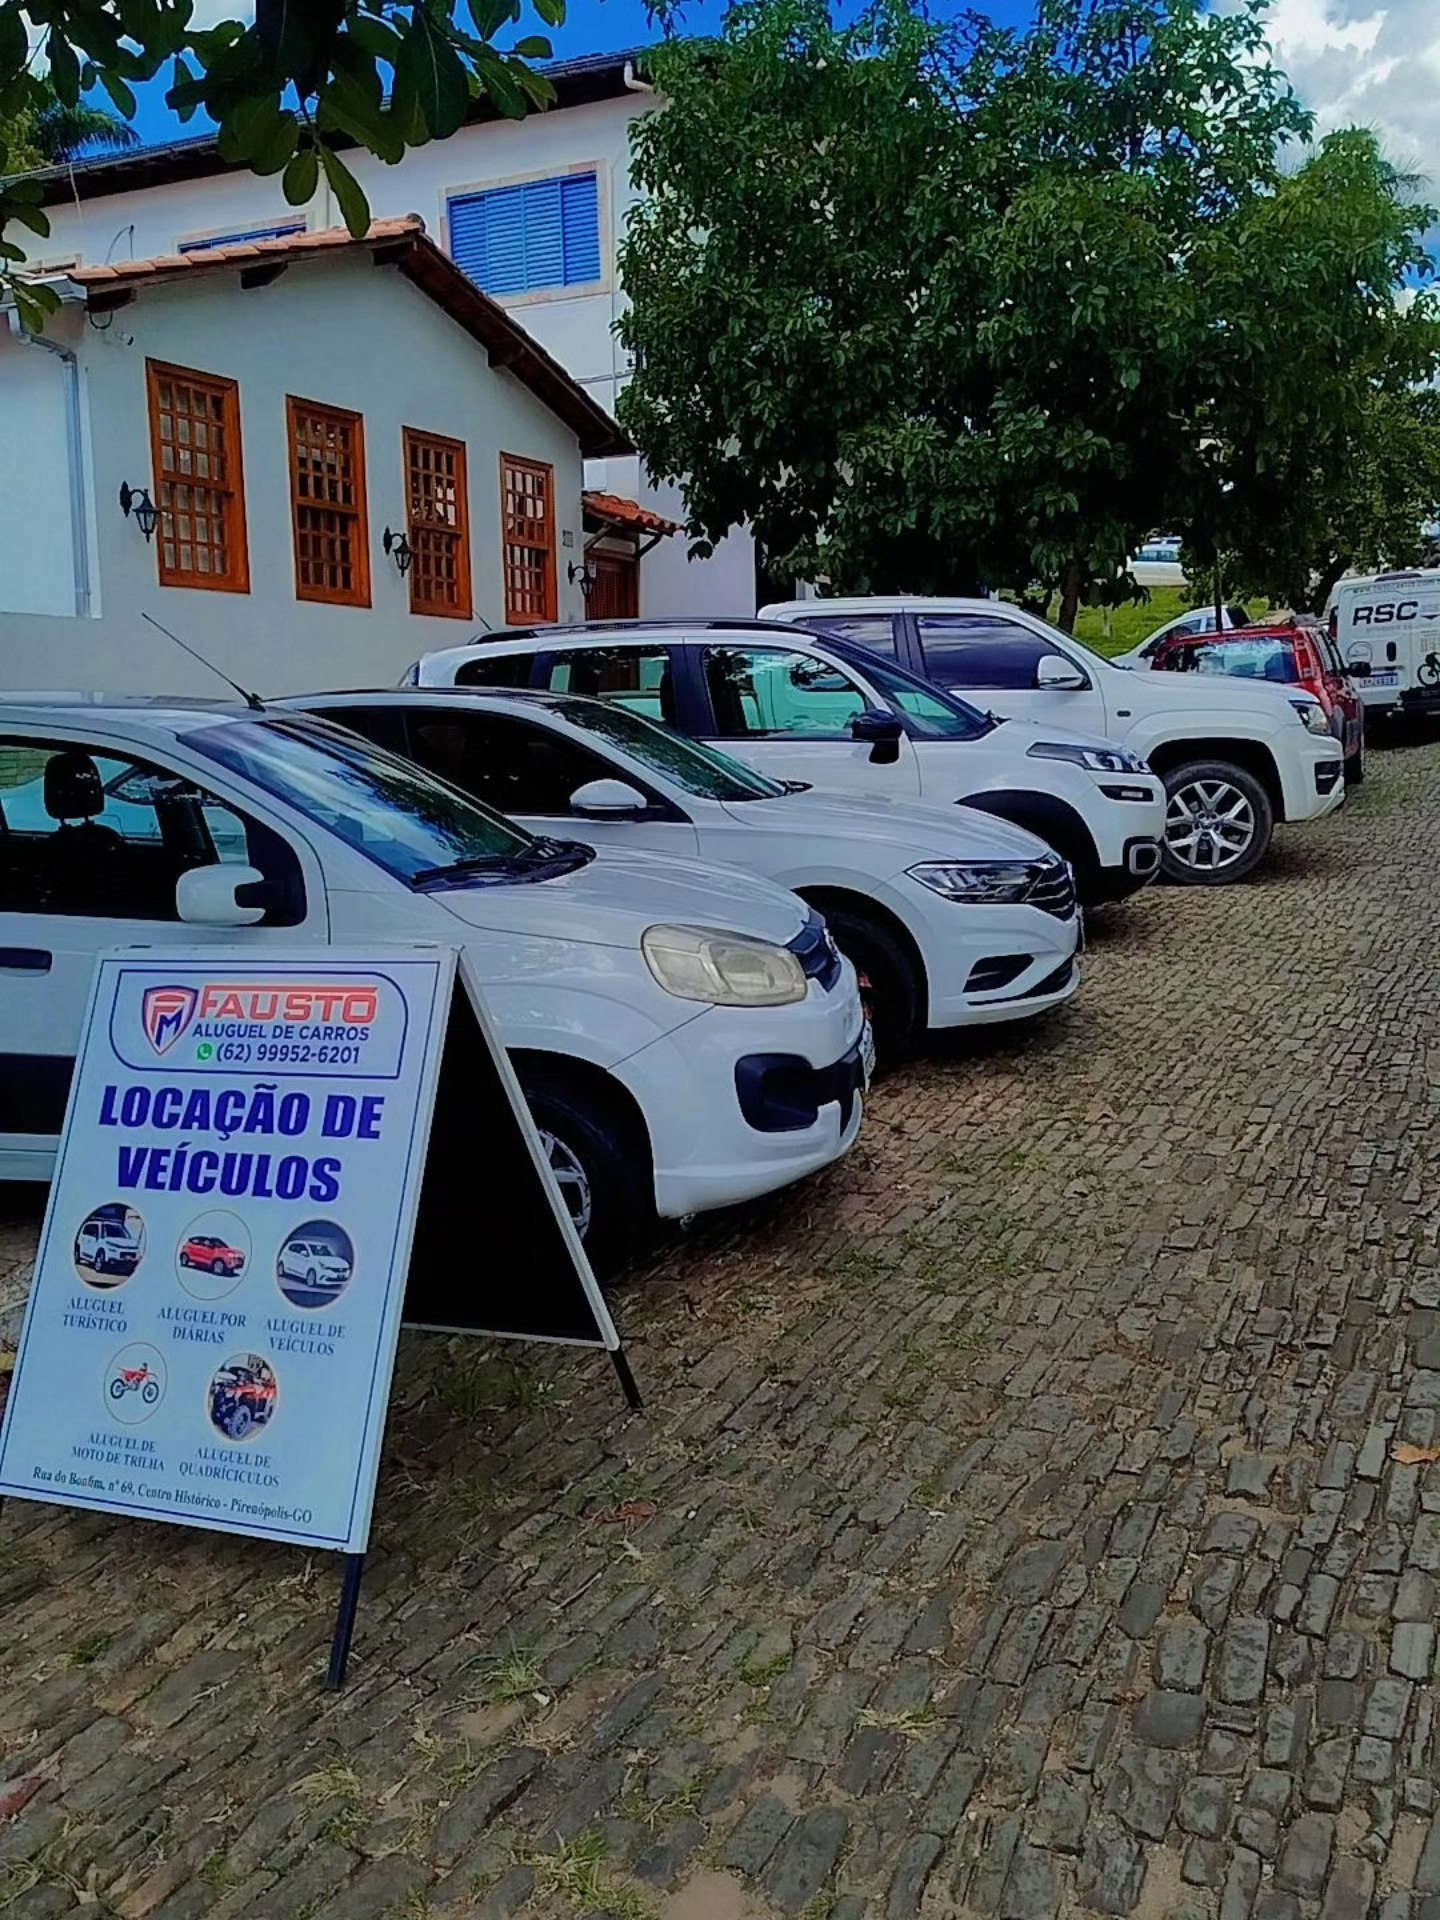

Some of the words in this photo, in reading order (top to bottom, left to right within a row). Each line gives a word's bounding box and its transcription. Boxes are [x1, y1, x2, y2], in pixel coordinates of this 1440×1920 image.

[1352, 601, 1418, 626] RSC
[199, 985, 378, 1024] FAUSTO
[192, 1023, 266, 1039] ALUGUEL
[271, 1025, 295, 1040] DE
[298, 1025, 370, 1042] CARROS
[216, 1043, 251, 1063] (62)
[256, 1043, 360, 1064] 99952-6201
[98, 1083, 311, 1141] LOCAÇÃO
[321, 1094, 385, 1140] DE
[117, 1141, 342, 1202] VEÍCULOS
[67, 1297, 125, 1314] ALUGUEL
[62, 1313, 128, 1333] TURÍSTICO
[157, 1306, 218, 1326] ALUGUEL
[219, 1313, 247, 1328] POR
[172, 1324, 225, 1344] DIÁRIAS
[265, 1318, 324, 1337] ALUGUEL
[327, 1324, 346, 1339] DE
[268, 1334, 335, 1356] VEÍCULOS
[87, 1432, 139, 1450] ALUGUEL
[141, 1439, 156, 1453] DE
[71, 1445, 105, 1461] MOTO
[106, 1450, 121, 1465] DE
[123, 1453, 165, 1471] TRILHA
[196, 1446, 252, 1467] ALUGUEL
[254, 1454, 273, 1469] DE
[33, 1465, 52, 1481] Rua
[138, 1483, 173, 1501] Centro
[174, 1488, 221, 1509] Histórico
